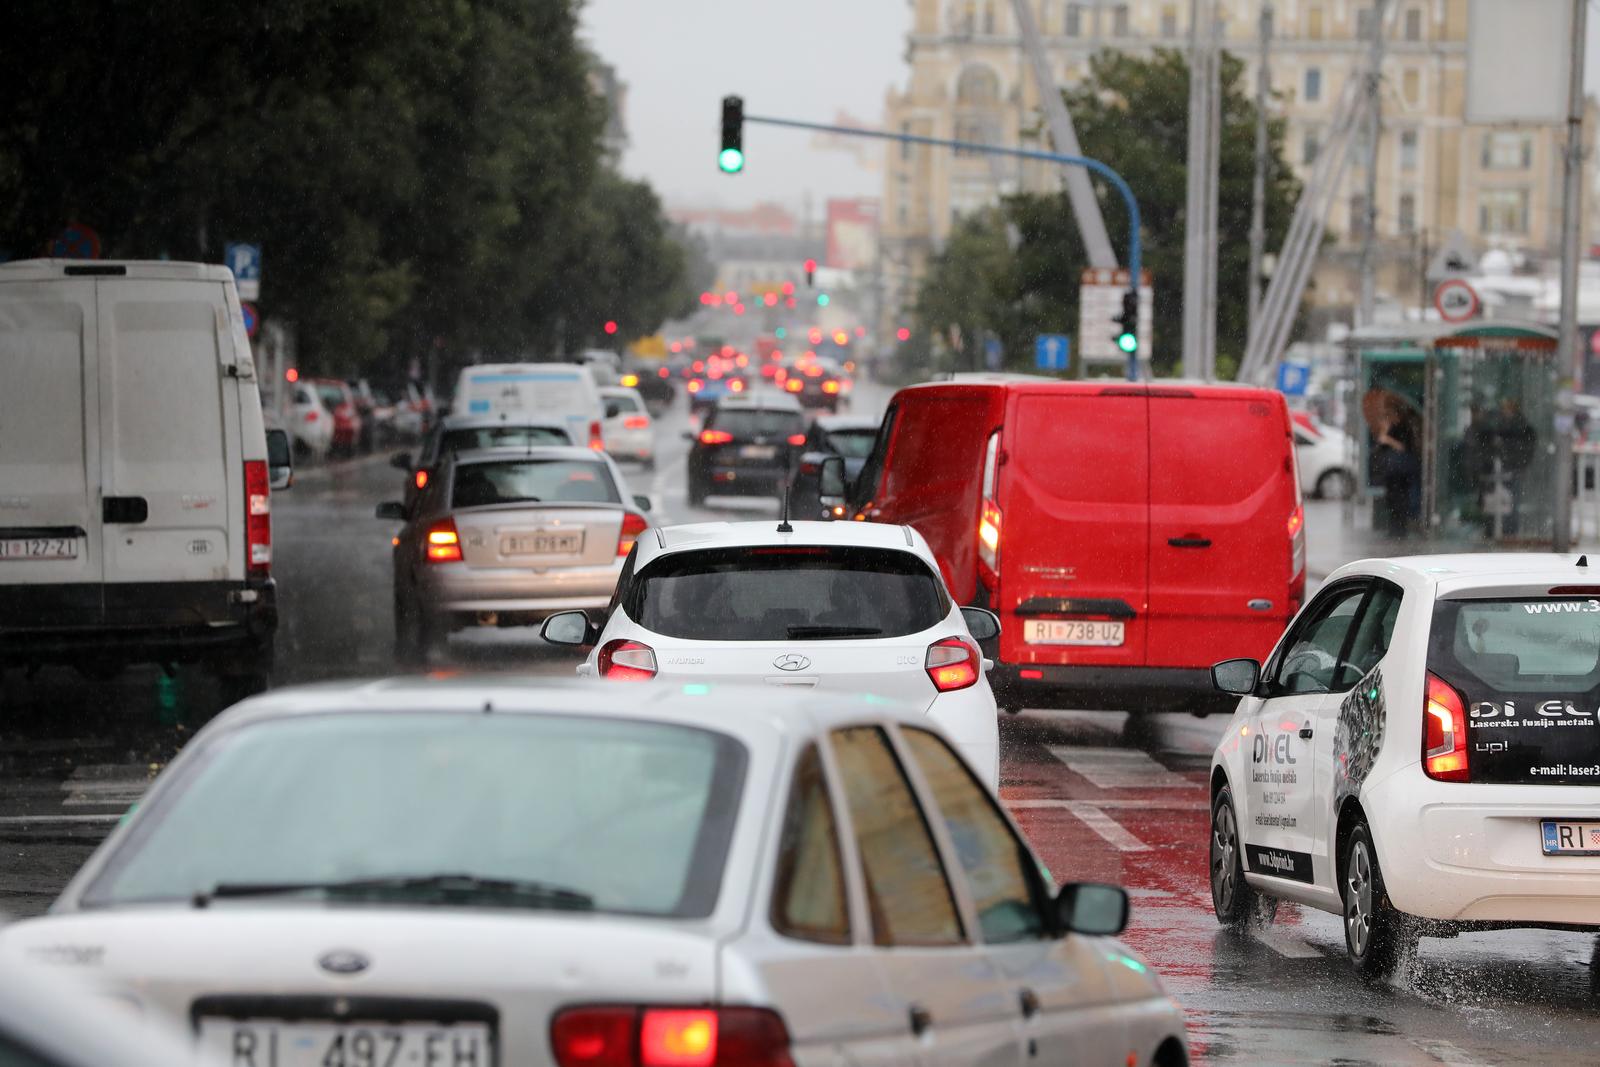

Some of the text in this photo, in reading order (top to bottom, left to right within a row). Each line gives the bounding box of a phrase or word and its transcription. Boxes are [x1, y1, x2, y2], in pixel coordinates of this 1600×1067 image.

[1036, 622, 1121, 640] RI 738-UZ
[1469, 718, 1594, 728] Laserska fuzija metala
[1475, 740, 1508, 754] up!
[1530, 764, 1567, 775] e-mail:
[1546, 839, 1558, 847] HR
[1559, 826, 1584, 848] RI
[233, 1028, 279, 1067] RI
